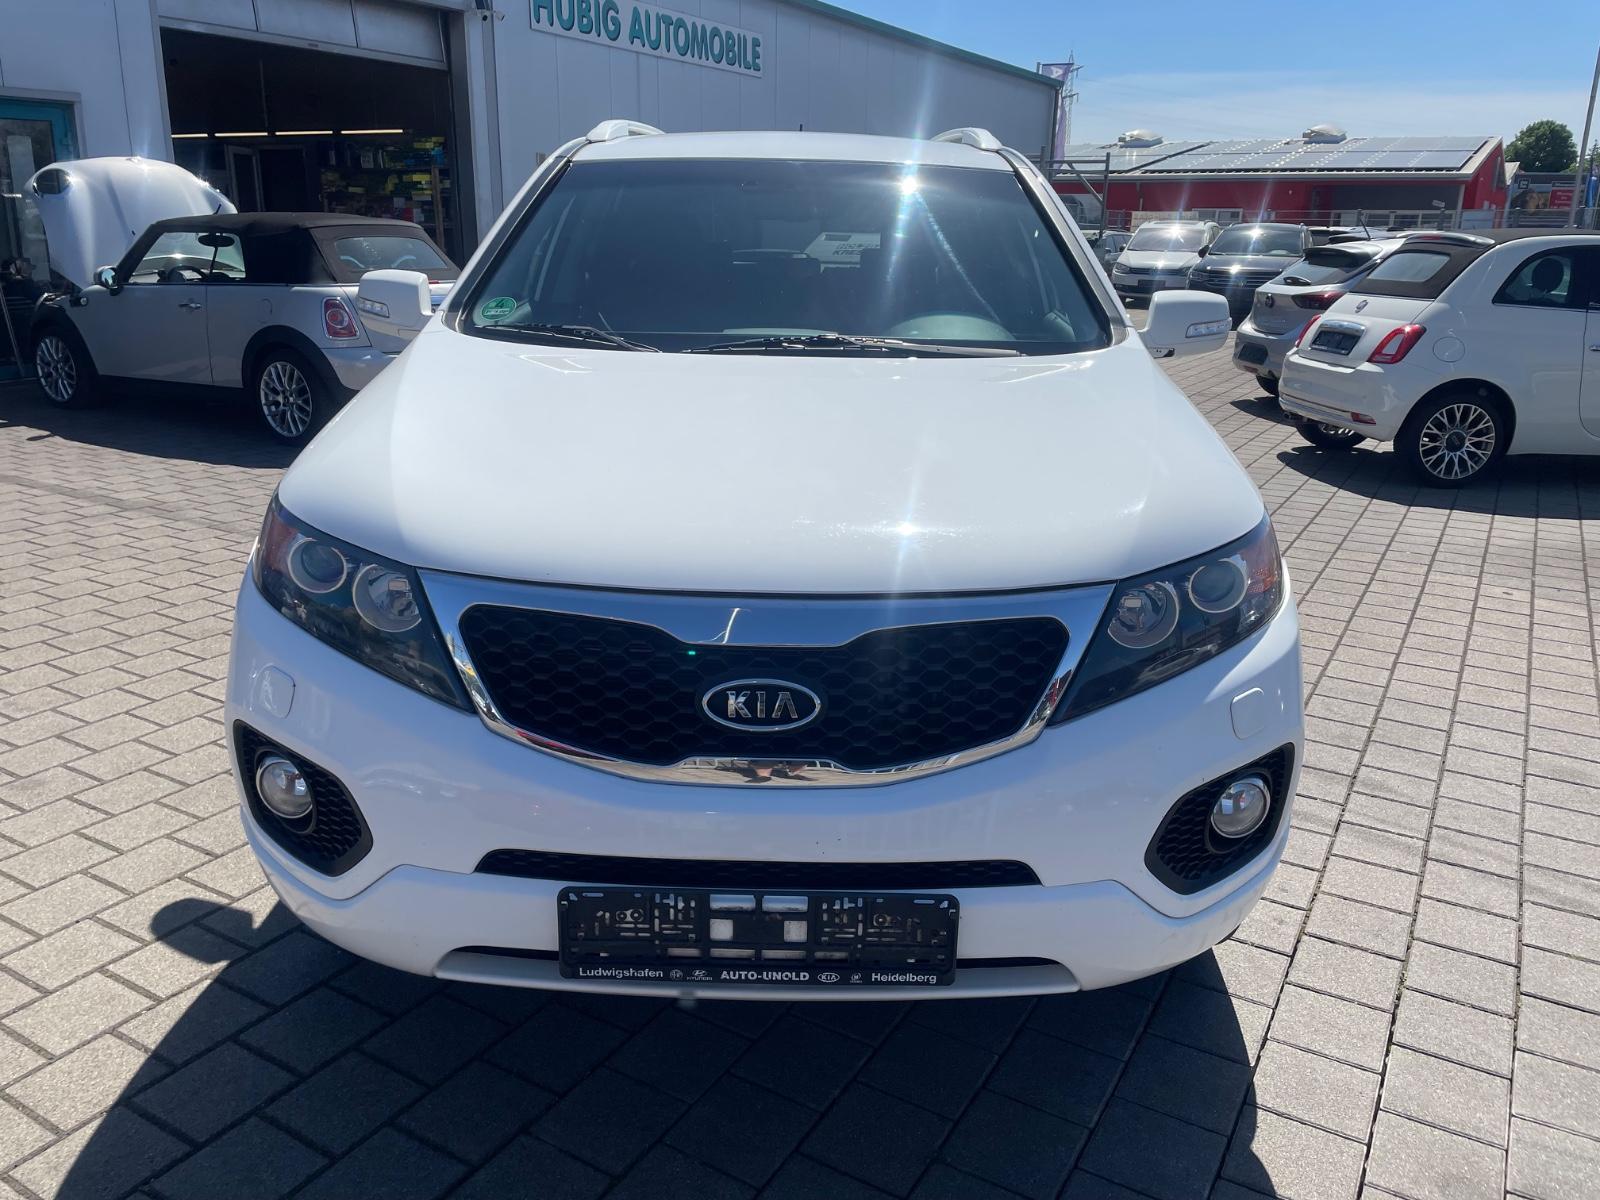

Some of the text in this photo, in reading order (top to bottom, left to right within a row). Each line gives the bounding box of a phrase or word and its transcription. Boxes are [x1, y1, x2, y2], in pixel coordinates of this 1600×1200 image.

[628, 6, 761, 72] AUTOMOBILE
[495, 298, 505, 309] 4
[726, 690, 799, 719] KIA
[579, 967, 664, 979] Ludwigshafen
[720, 970, 810, 981] AUTO-UNOLD
[871, 972, 937, 984] Heidelberg
